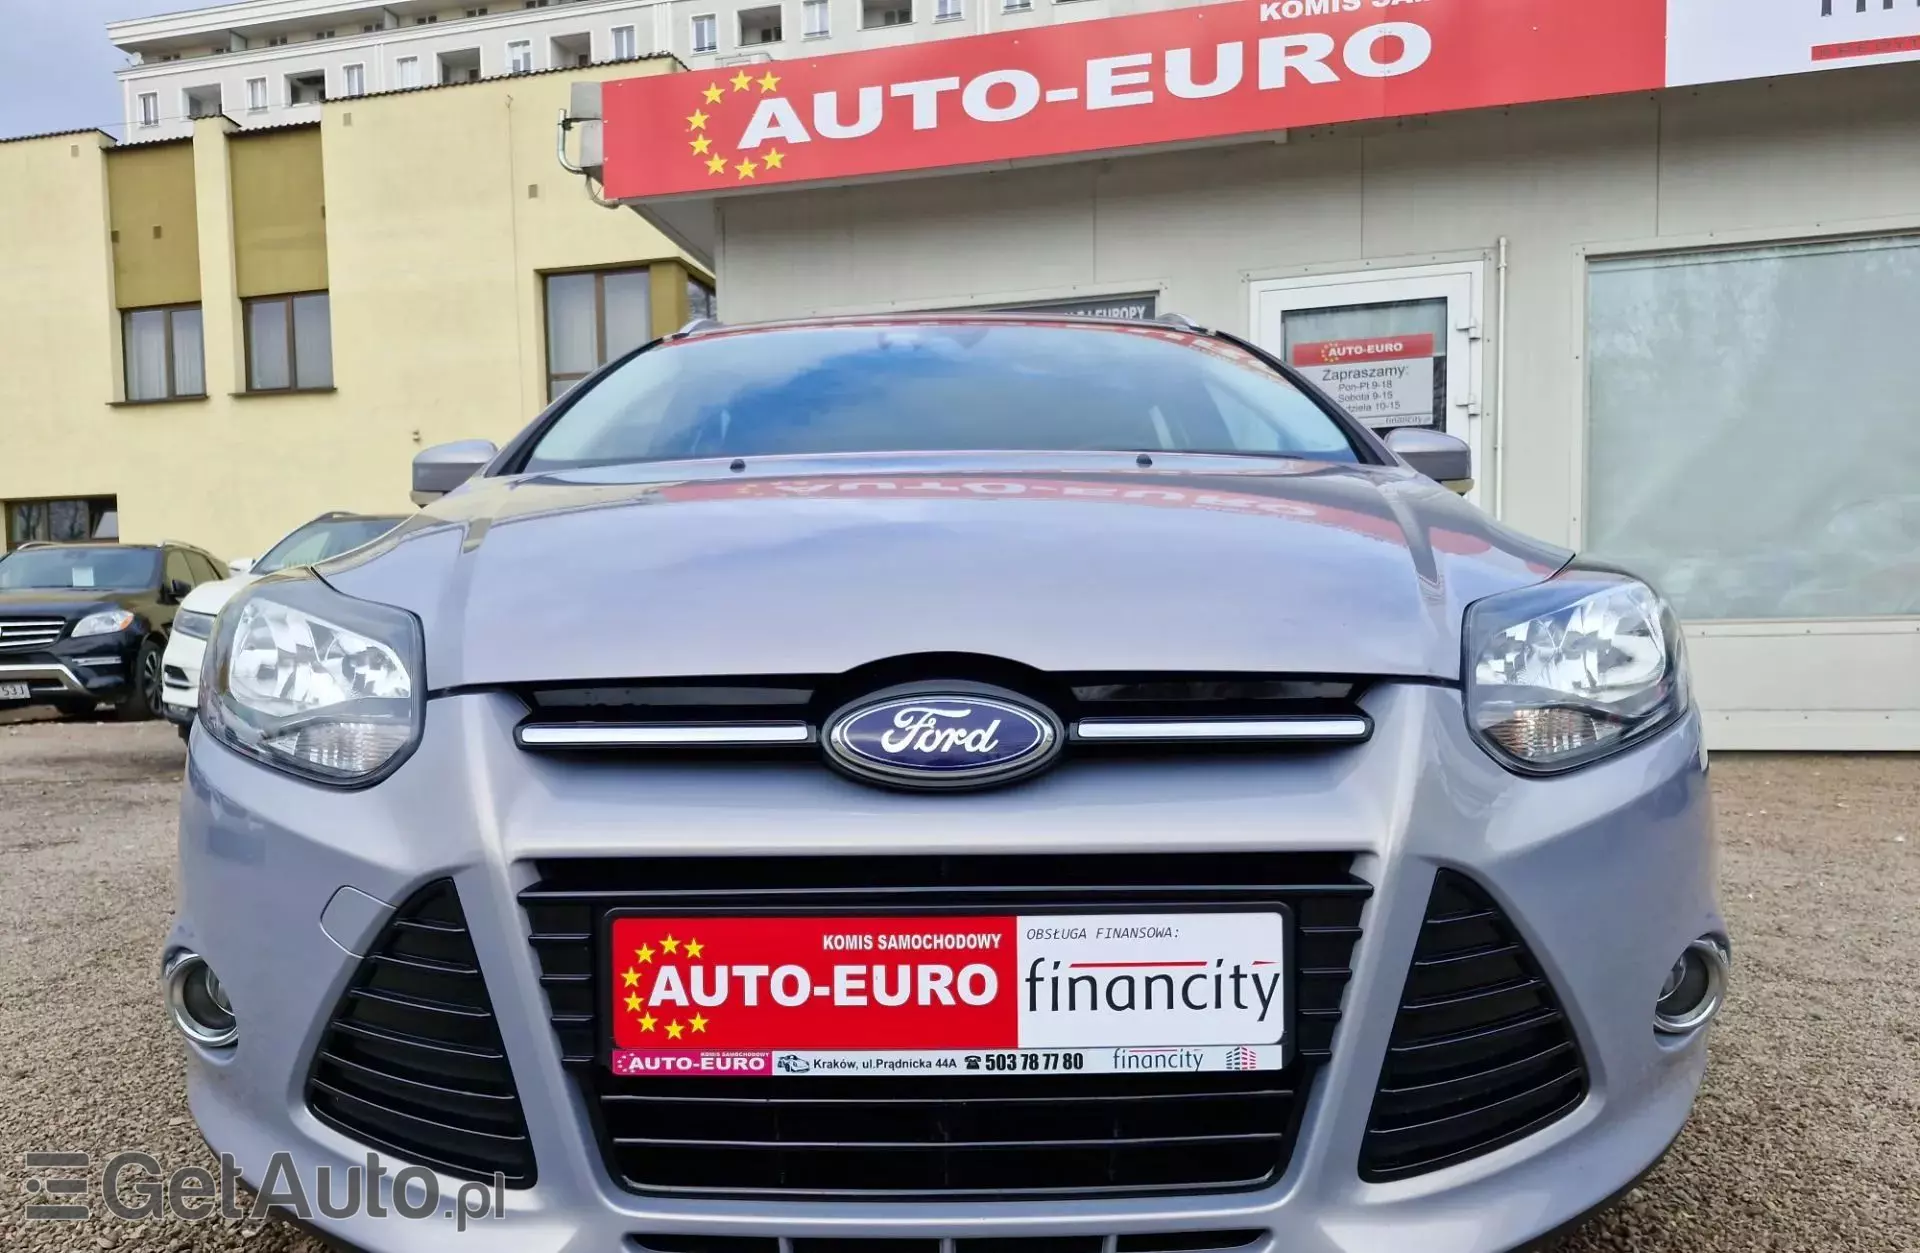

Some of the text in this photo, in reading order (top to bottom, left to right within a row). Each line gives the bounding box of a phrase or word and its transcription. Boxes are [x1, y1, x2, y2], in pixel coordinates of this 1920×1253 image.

[1260, 0, 1361, 22] KOMIS
[737, 21, 1432, 149] AUTO-EURO
[1328, 343, 1403, 357] AUTO-EURO
[1322, 365, 1409, 382] Zapraszamy:
[1371, 380, 1393, 390] 9-18
[1338, 393, 1370, 403] Sobota
[1375, 401, 1400, 411] 10-15
[881, 707, 1001, 753] Ford
[823, 933, 1002, 951] KOMIS SAMOCHODOWY
[1026, 927, 1180, 940] OBSŁUGA FINANSOWA:
[648, 964, 998, 1007] AUTO-EURO
[1025, 957, 1280, 1022] financity
[629, 1057, 765, 1071] AUTO-EURO
[813, 1059, 858, 1070] Kraków,
[936, 1059, 957, 1069] 44A
[985, 1053, 1083, 1070] 503 78 77 80
[1113, 1048, 1203, 1072] financity
